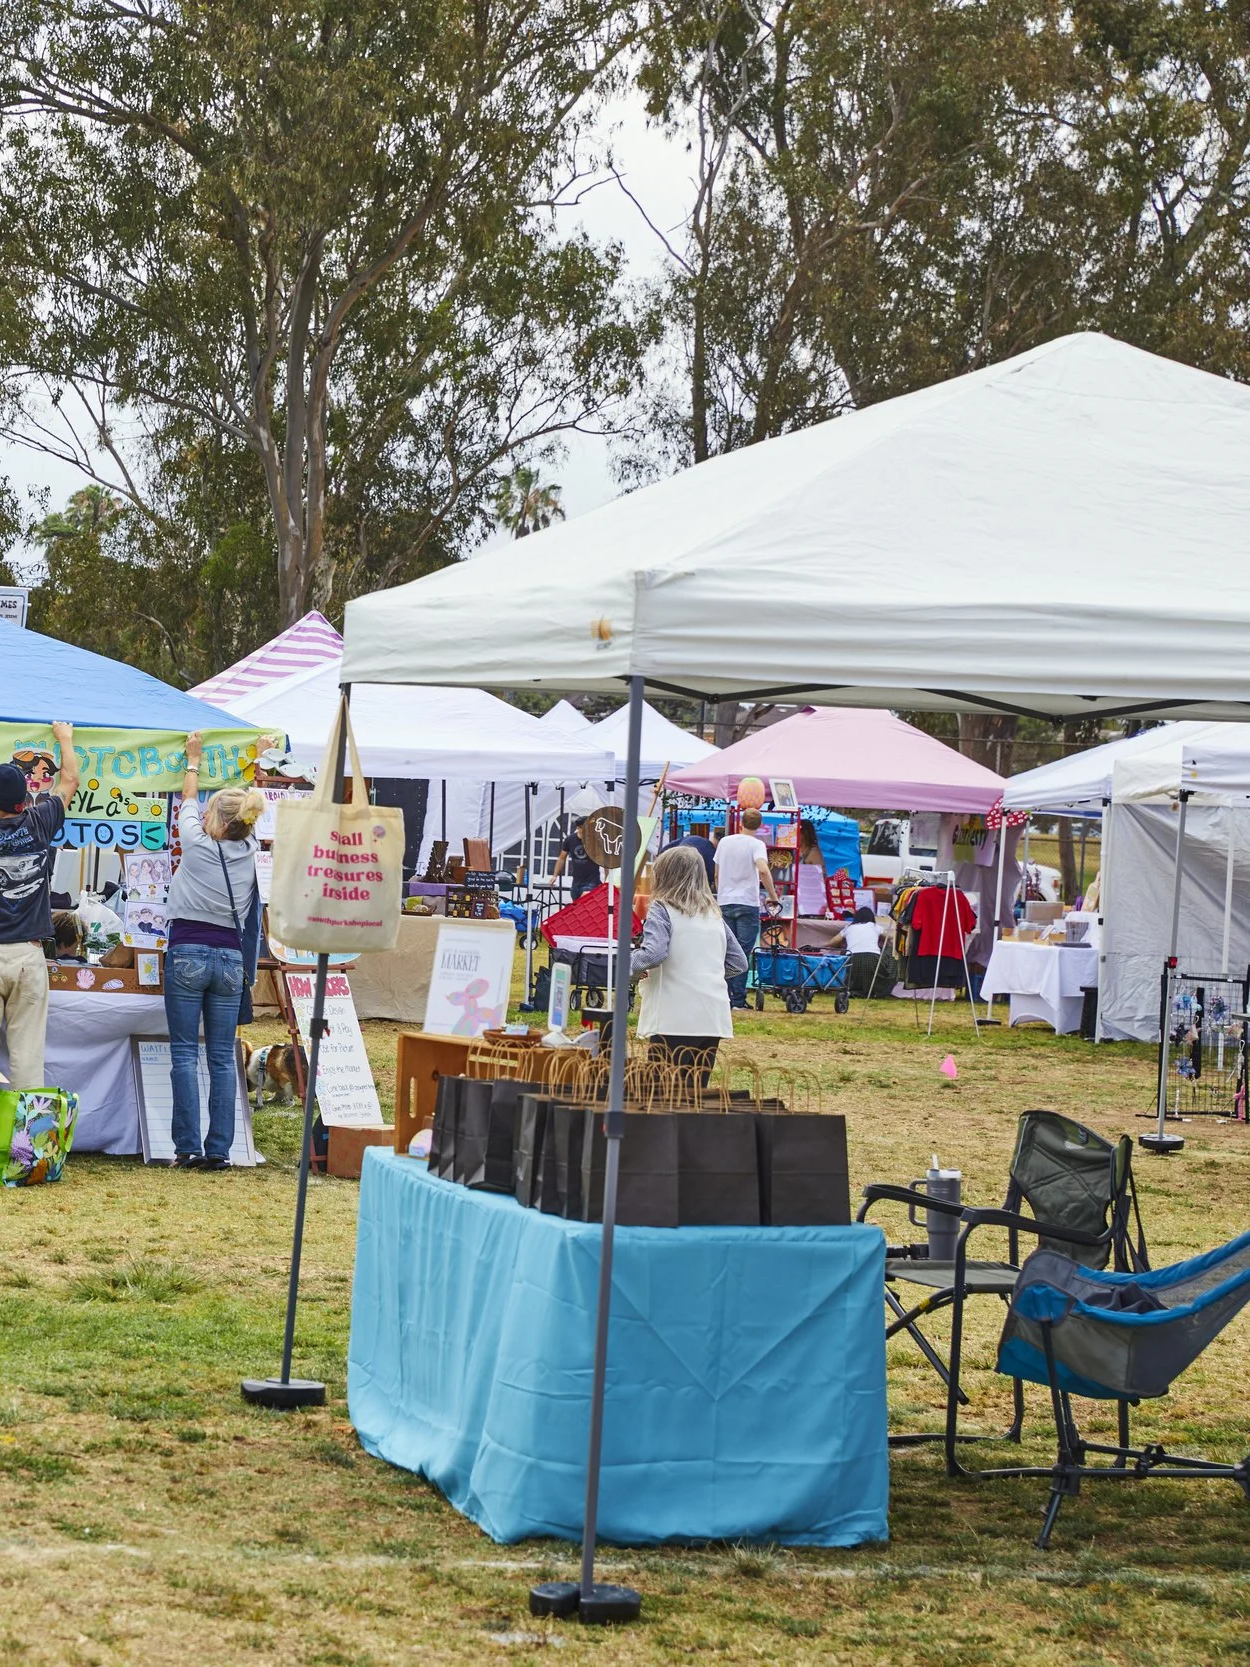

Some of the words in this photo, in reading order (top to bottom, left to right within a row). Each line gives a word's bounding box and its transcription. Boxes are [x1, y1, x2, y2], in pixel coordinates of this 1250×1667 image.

[329, 831, 364, 846] sall
[313, 844, 379, 864] buness
[307, 864, 384, 883] tresures
[313, 976, 350, 998] ORKS
